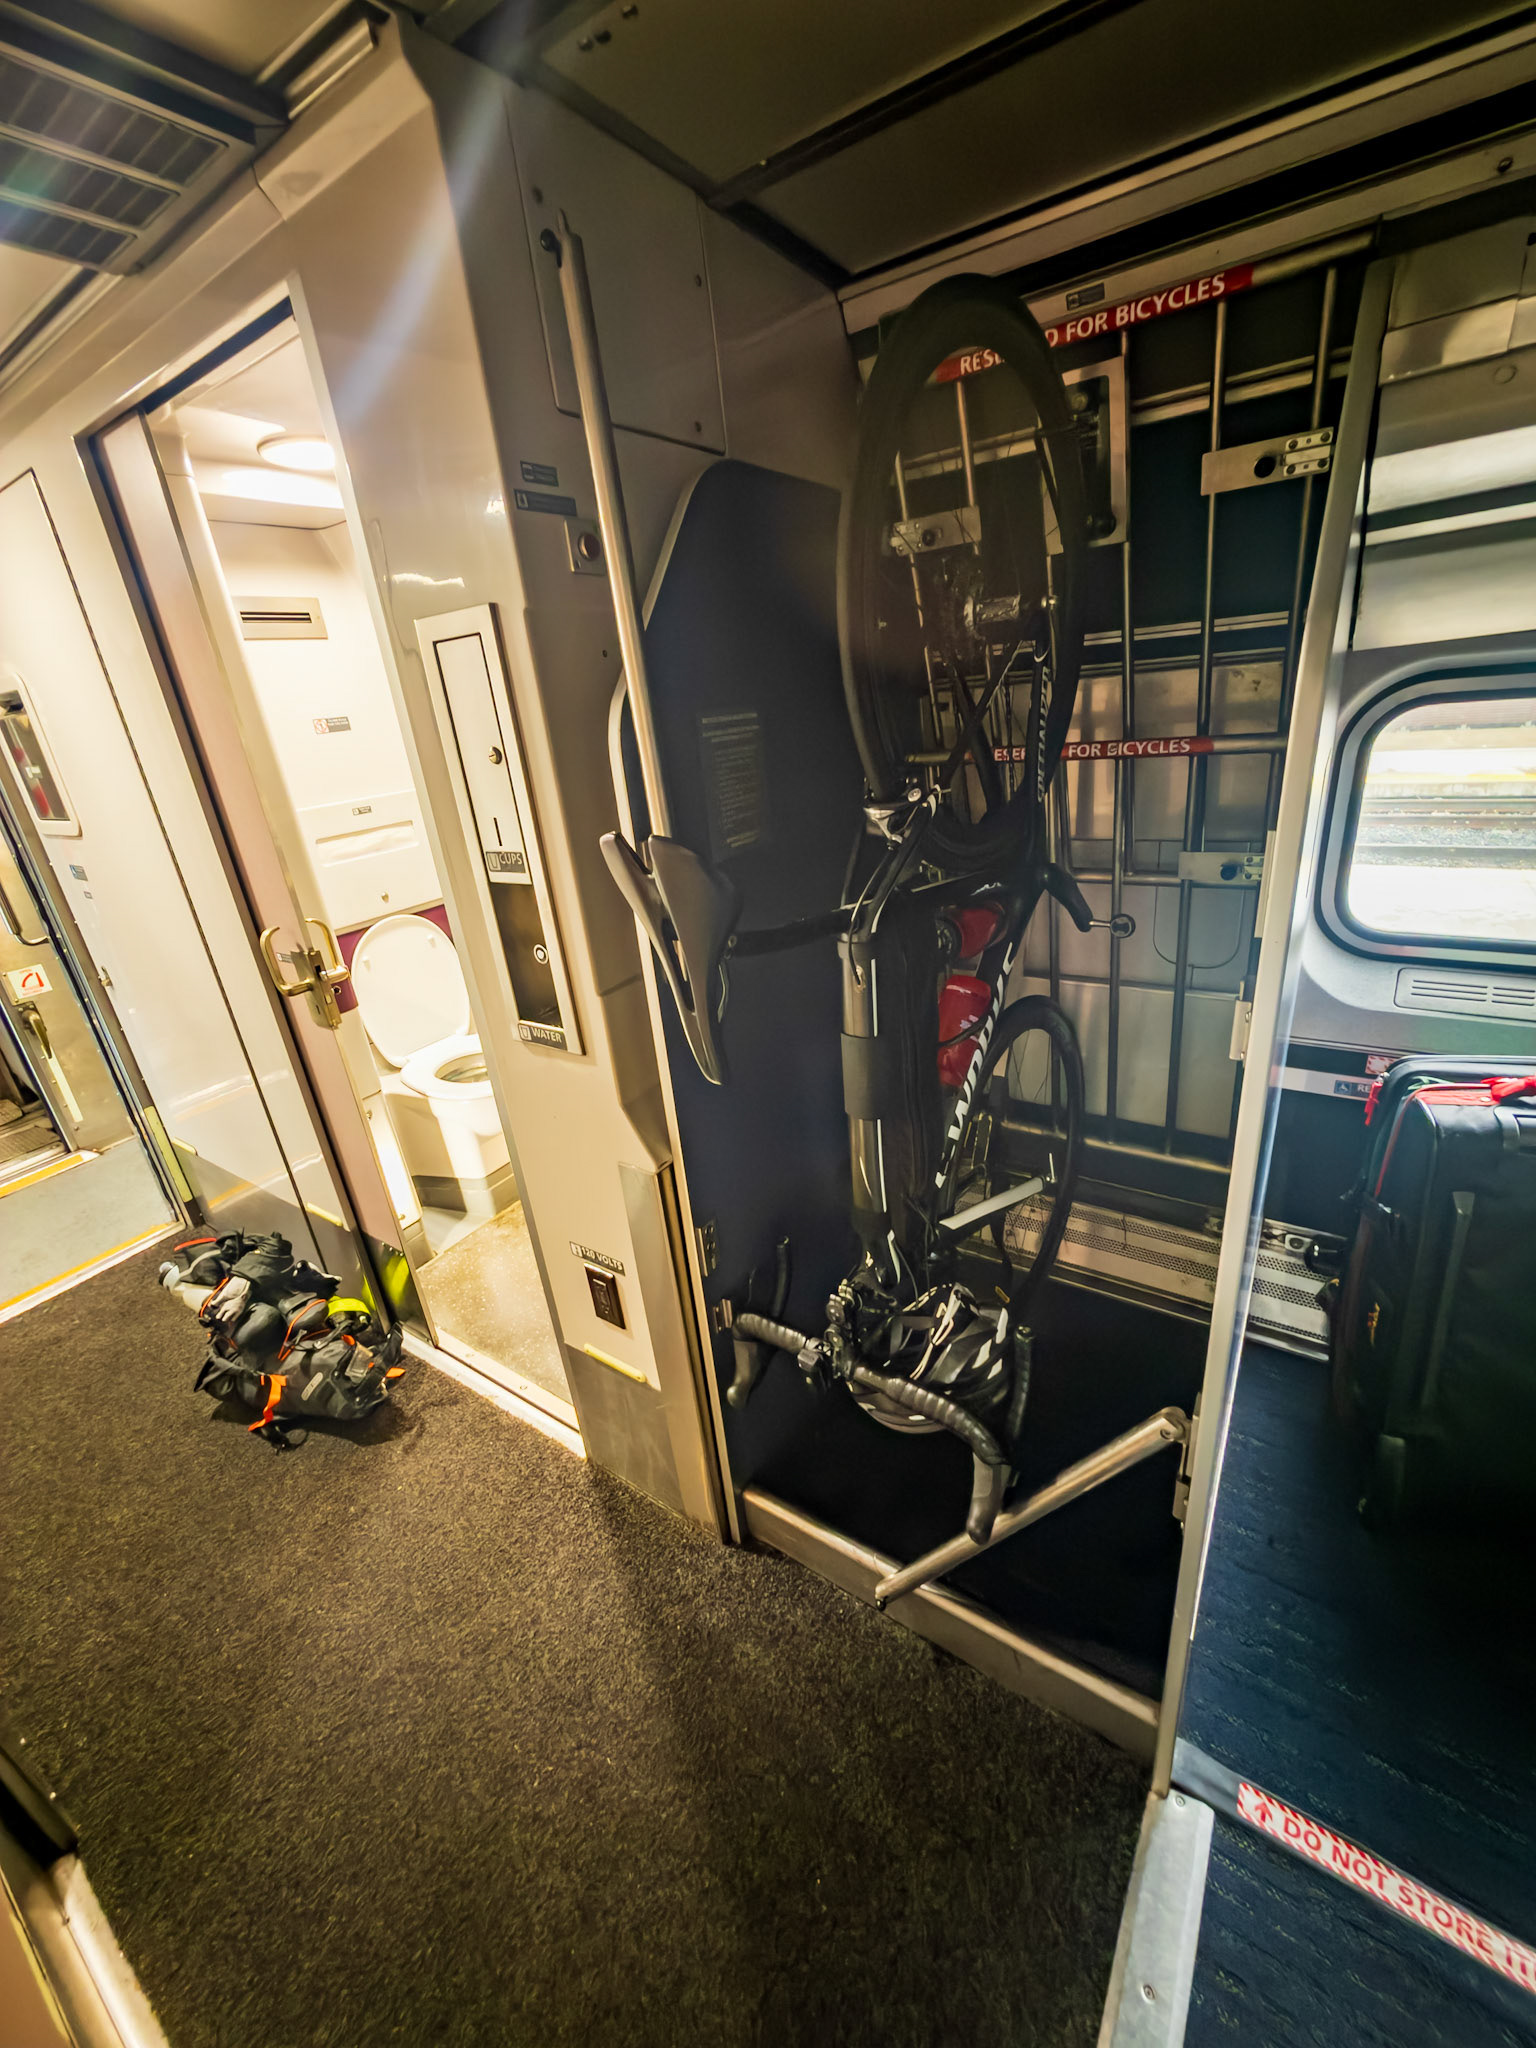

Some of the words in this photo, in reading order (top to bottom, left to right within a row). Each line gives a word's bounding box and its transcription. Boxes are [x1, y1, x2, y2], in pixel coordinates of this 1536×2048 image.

[1065, 312, 1109, 343] FOR
[1115, 272, 1226, 327] BICYCLES
[1067, 743, 1102, 759] FOR
[1106, 738, 1191, 757] BICYCLES
[500, 852, 523, 865] CUPS
[530, 1026, 562, 1044] WATER
[596, 1252, 623, 1271] VOLTS
[1283, 1816, 1323, 1852] DO
[1332, 1844, 1389, 1891] NOT
[1398, 1884, 1494, 1957] STORE
